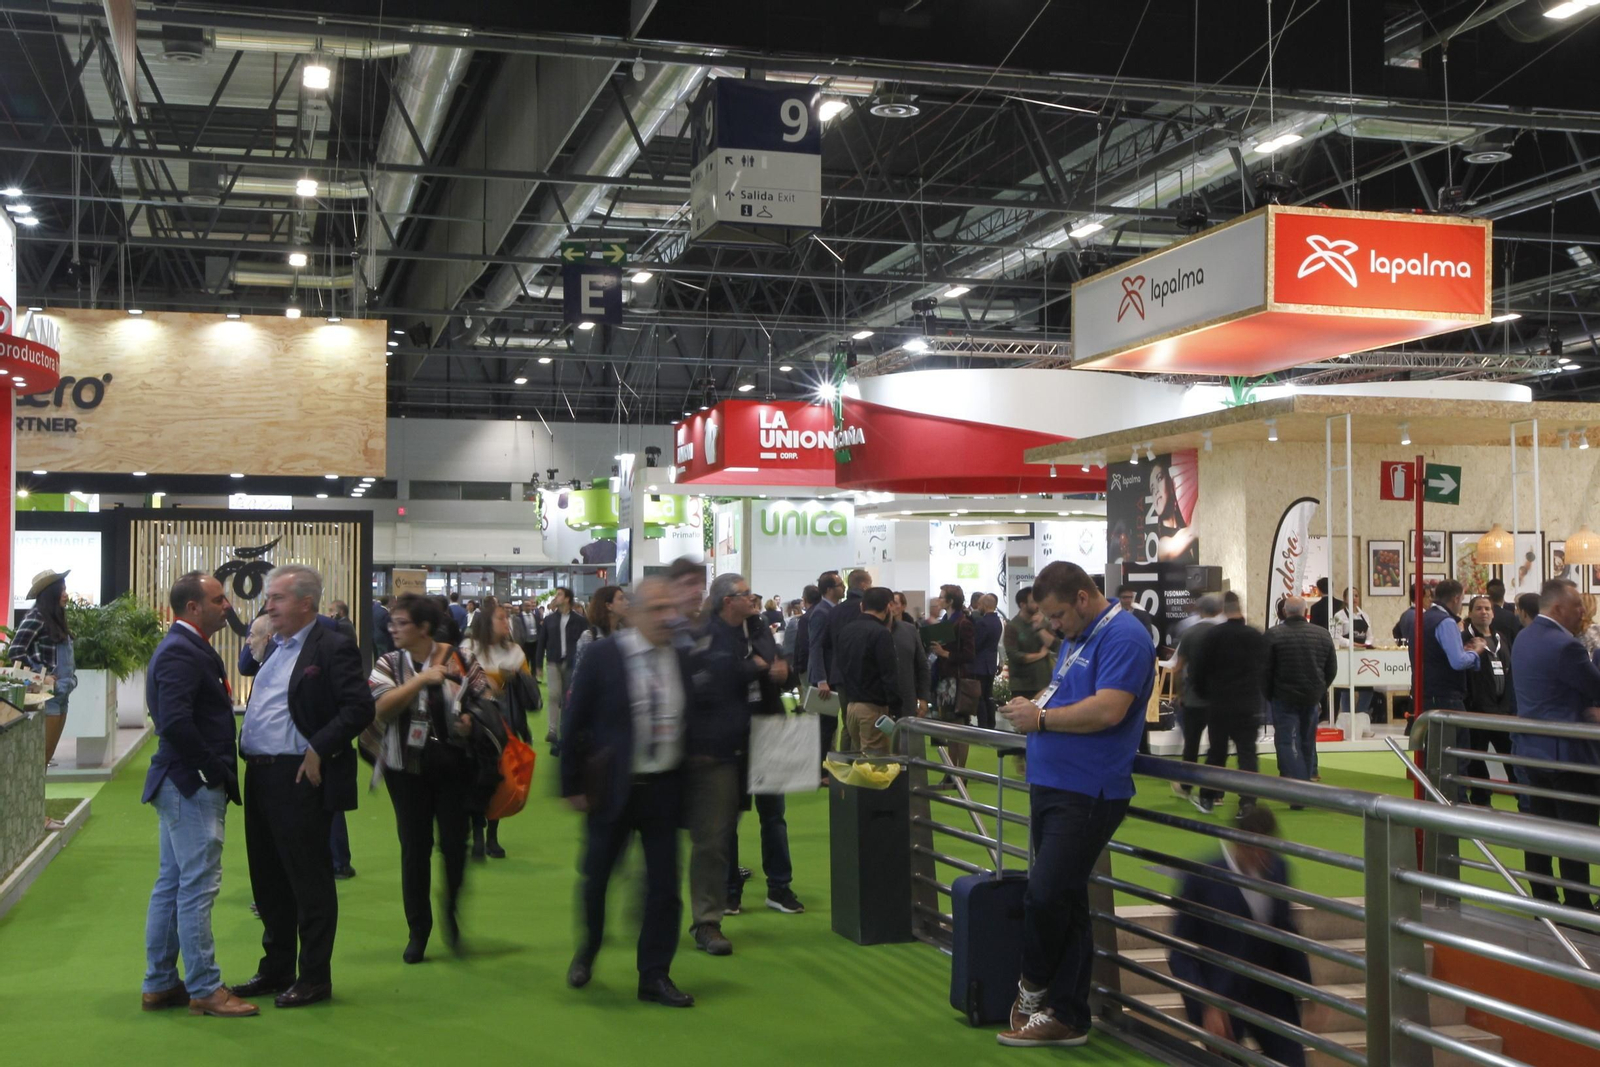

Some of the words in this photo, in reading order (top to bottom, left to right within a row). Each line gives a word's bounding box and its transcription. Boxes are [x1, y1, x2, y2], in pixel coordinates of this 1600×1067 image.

[705, 100, 714, 147] 9
[779, 98, 809, 143] 9
[740, 189, 774, 202] Salida
[777, 192, 796, 203] Exit
[1370, 249, 1472, 284] lapalma
[580, 274, 606, 315] E
[1150, 266, 1205, 307] lapalma
[759, 410, 790, 429] LA
[759, 430, 835, 449] UNION
[779, 452, 799, 460] CORP.
[1122, 475, 1142, 488] lapalma
[760, 508, 848, 537] unica
